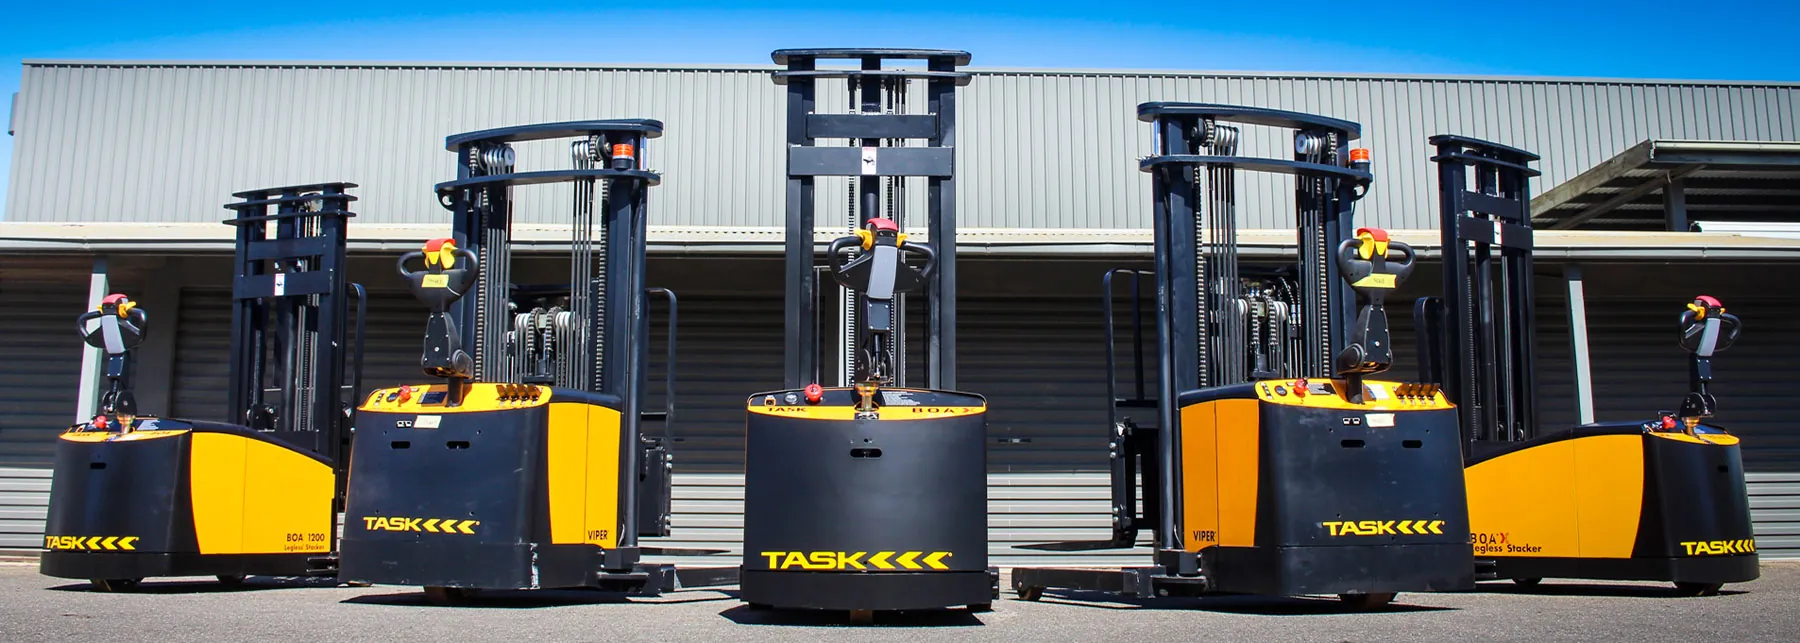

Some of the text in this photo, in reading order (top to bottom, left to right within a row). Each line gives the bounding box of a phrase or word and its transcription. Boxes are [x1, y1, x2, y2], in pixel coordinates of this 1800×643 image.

[362, 516, 423, 532] TASK
[1322, 520, 1397, 536] TASK
[46, 535, 87, 550] TASK
[286, 533, 325, 542] BOA 1200
[587, 529, 608, 541] VIPER
[1192, 530, 1216, 542] VIPER
[1474, 543, 1542, 554] egless Stacker
[1680, 540, 1737, 555] TASK
[761, 550, 867, 570] TASK
